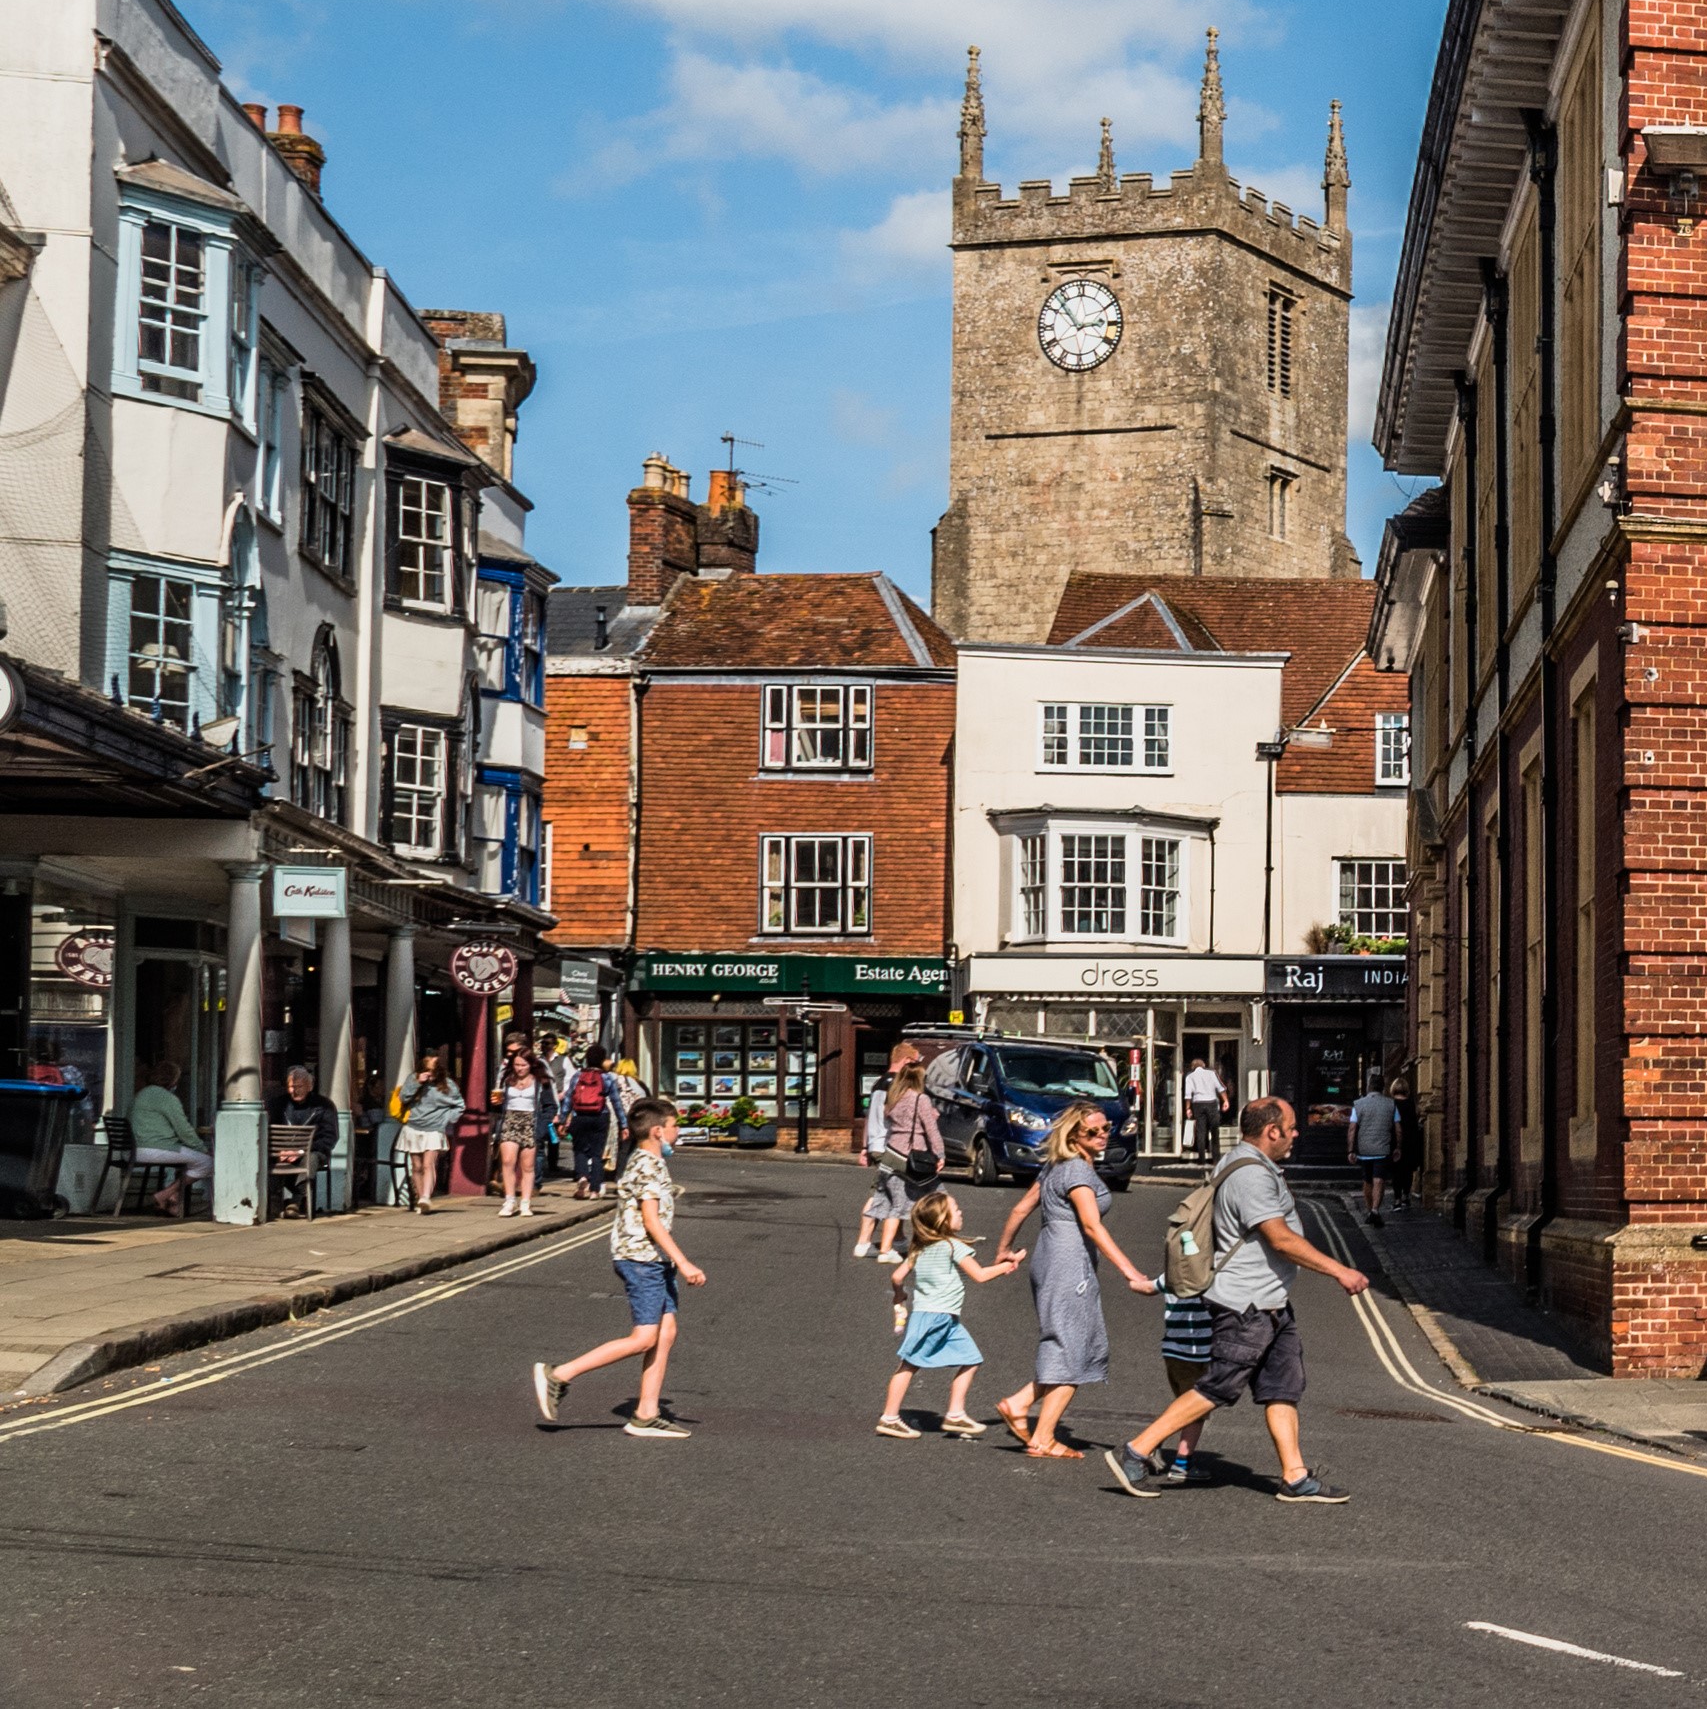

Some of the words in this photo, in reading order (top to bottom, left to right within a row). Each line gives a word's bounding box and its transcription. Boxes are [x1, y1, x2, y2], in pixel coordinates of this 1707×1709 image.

[652, 963, 708, 977] HENRY
[711, 963, 779, 977] GEORGE
[855, 964, 905, 981] Estate
[906, 966, 949, 985] Agen
[1081, 962, 1159, 987] dress
[1284, 965, 1325, 994] Raj
[458, 971, 510, 991] COFFEE
